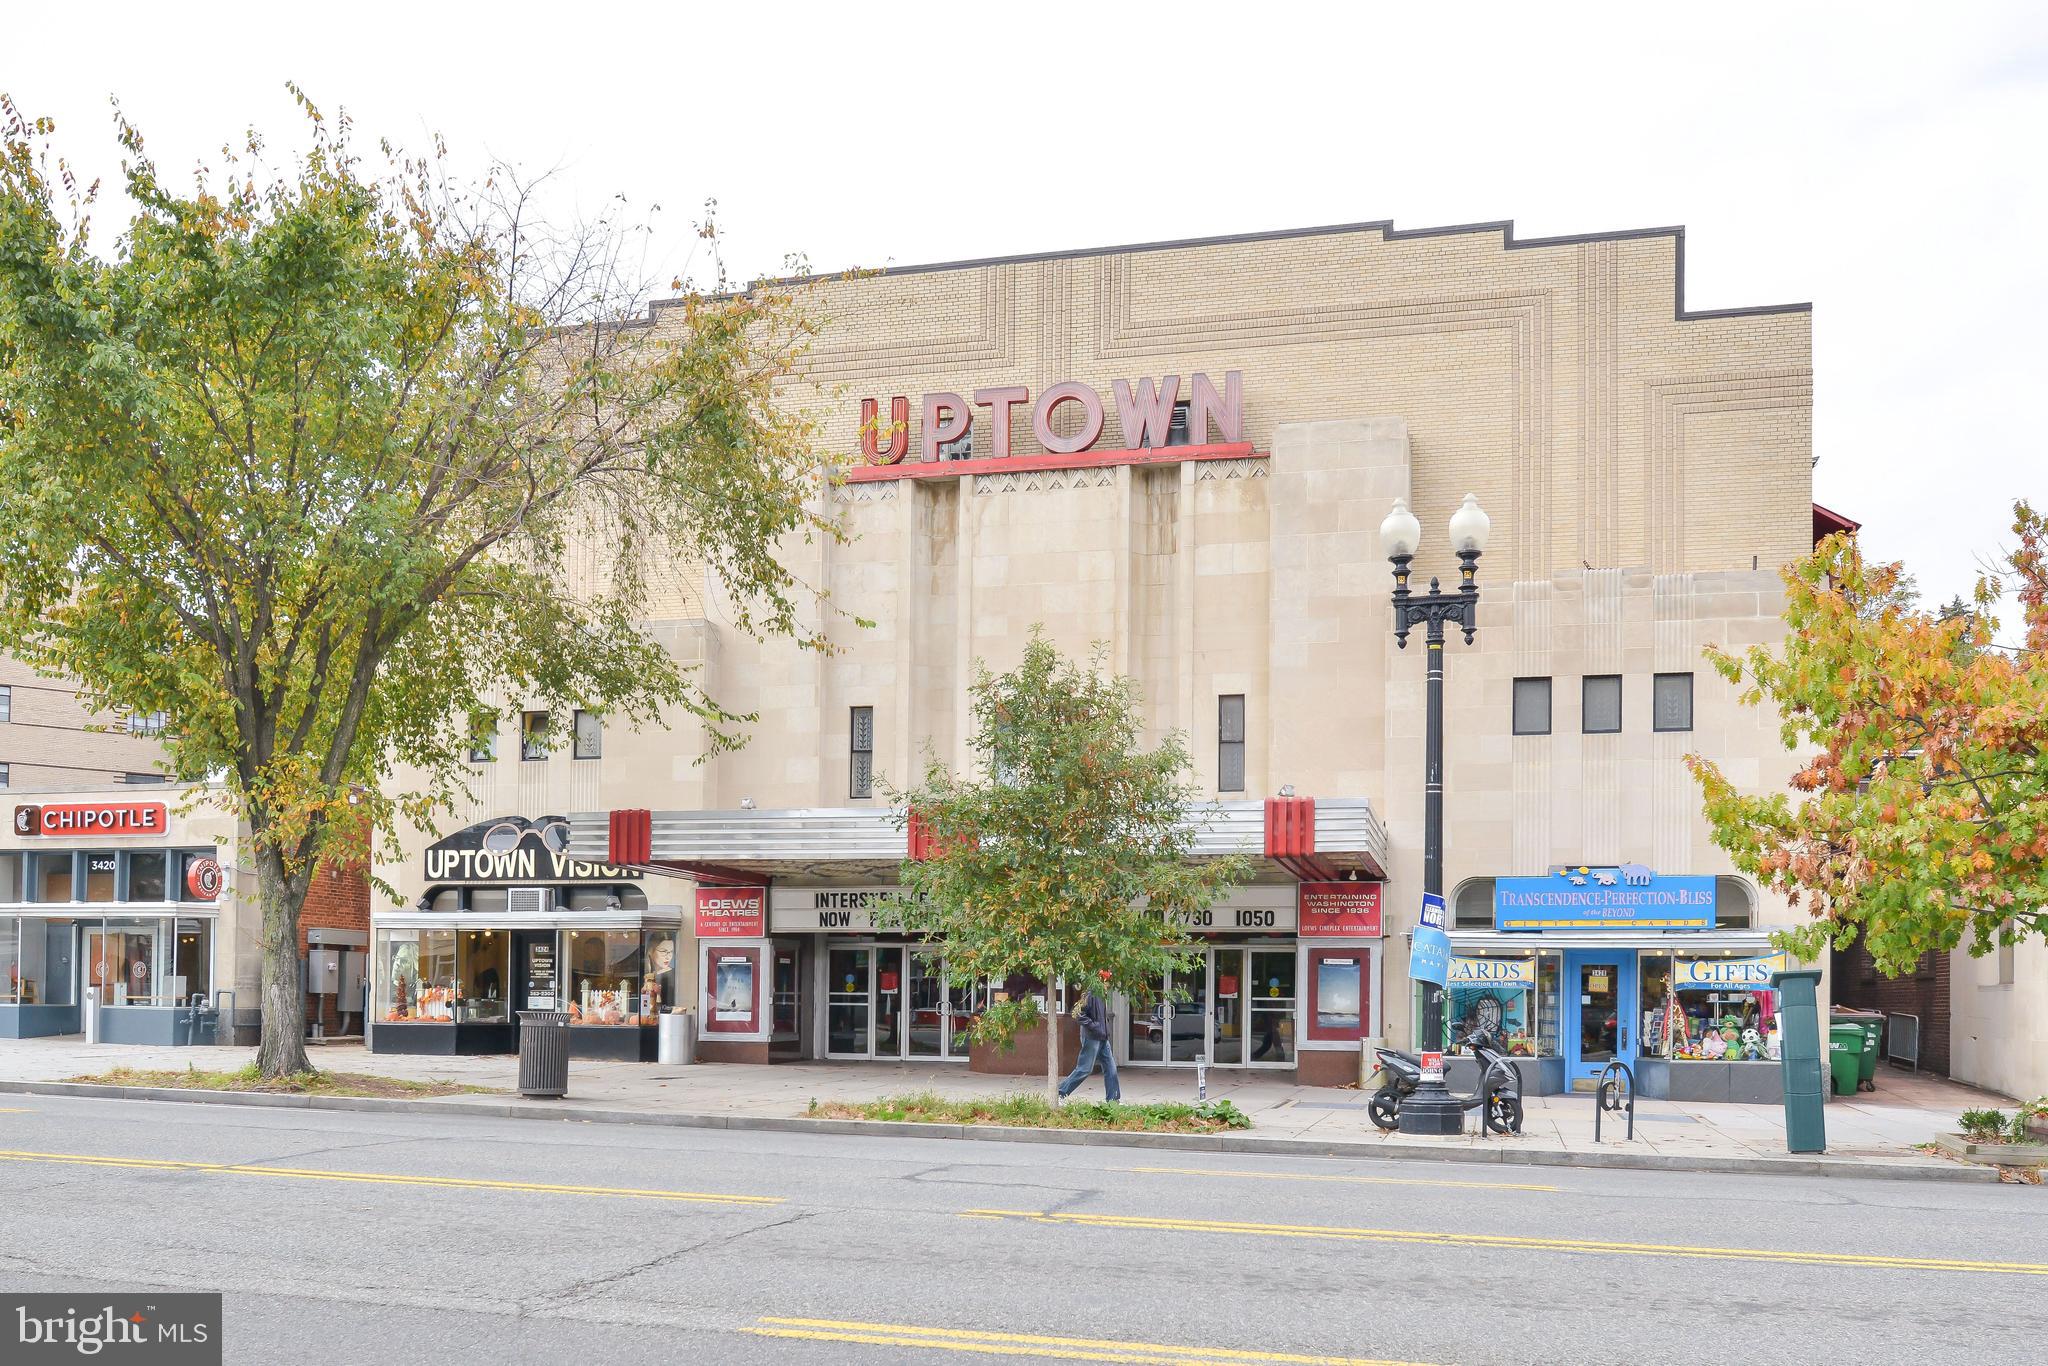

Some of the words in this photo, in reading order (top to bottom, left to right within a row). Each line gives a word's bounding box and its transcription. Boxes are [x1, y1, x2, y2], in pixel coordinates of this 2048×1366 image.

[860, 370, 1243, 466] UPTOWN
[43, 808, 156, 829] CHIPOTLE
[91, 860, 116, 870] 3420
[196, 860, 222, 877] CHIPOTLE
[427, 849, 535, 878] UPTOWN
[700, 898, 760, 909] LOEWS
[815, 892, 929, 908] INTERSTE
[700, 909, 760, 917] THEATRES
[819, 911, 851, 927] NOW
[1236, 910, 1275, 926] 1050
[1602, 908, 1635, 917] BEYOND
[1689, 960, 1768, 982] GIFTS
